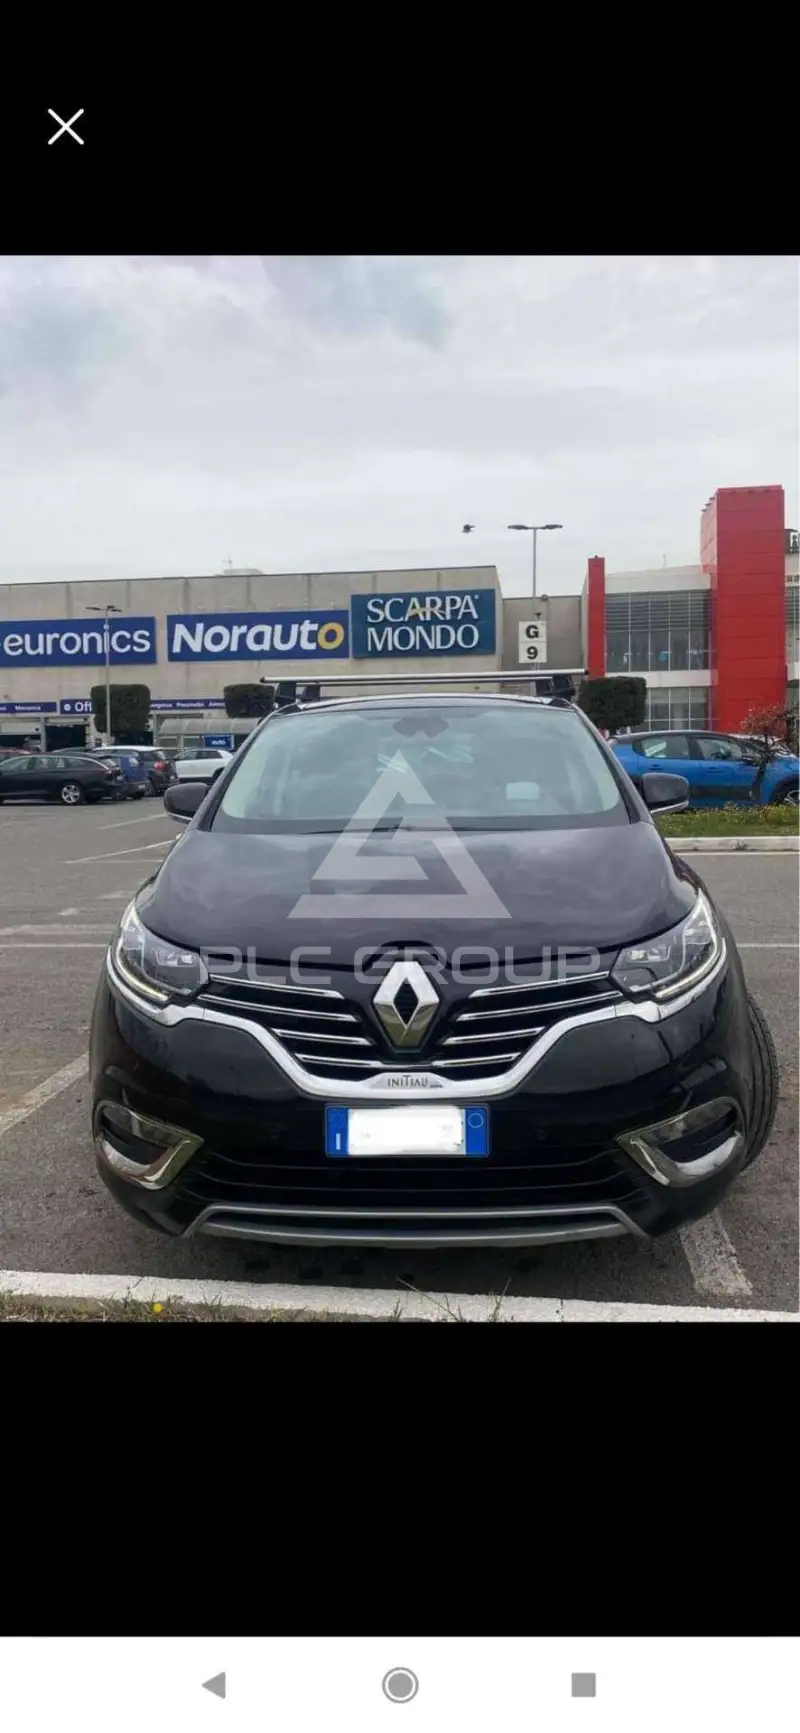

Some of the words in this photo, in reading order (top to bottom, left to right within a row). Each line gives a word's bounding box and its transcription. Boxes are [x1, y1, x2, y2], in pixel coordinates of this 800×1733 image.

[366, 595, 479, 623] SCARPA
[3, 623, 151, 656] euronics
[172, 620, 345, 653] Norauto
[367, 624, 479, 651] MONDO
[525, 624, 539, 639] G
[527, 645, 538, 660] 9
